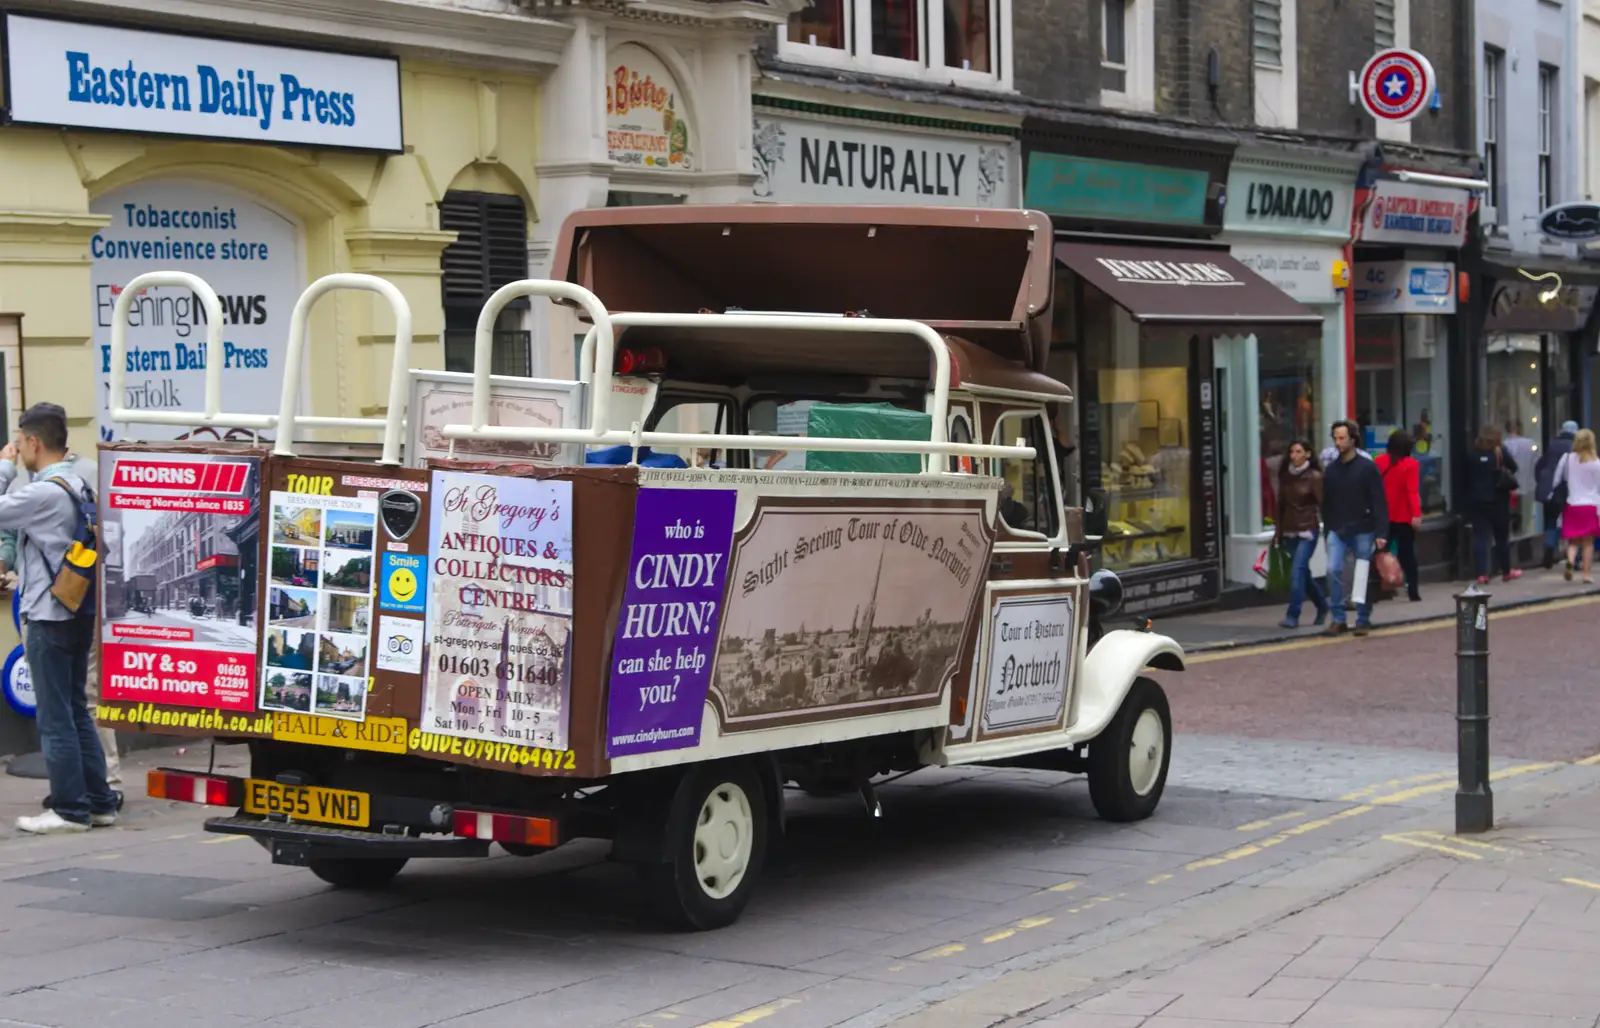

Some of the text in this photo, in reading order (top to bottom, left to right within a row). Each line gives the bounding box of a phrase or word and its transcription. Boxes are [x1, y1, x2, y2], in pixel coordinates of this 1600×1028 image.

[66, 51, 356, 130] Eastern Daily Press
[614, 65, 667, 115] Bistro
[800, 137, 965, 196] NATURALLY
[1247, 182, 1333, 220] L'DARADO
[124, 203, 237, 229] Tobacconist
[91, 235, 268, 260] Convenience store
[1096, 257, 1235, 282] JEWELLERS
[101, 344, 171, 373] Estern
[224, 341, 268, 368] Press
[118, 465, 196, 485] THORNS
[287, 474, 334, 496] TOUR
[115, 495, 244, 511] Serving Norwich since 1835
[443, 485, 560, 532] St Gregory's
[665, 519, 705, 540] who is
[440, 532, 559, 560] ANTIQUES &
[742, 548, 789, 598] Sight
[793, 527, 843, 564] Seeing
[847, 517, 880, 541] Tour
[883, 517, 899, 540] of
[900, 520, 928, 551] Olde
[928, 536, 973, 588] Norwich
[389, 554, 420, 568] Smile
[435, 557, 566, 588] COLLECTORS
[635, 553, 722, 590] CINDY
[459, 587, 538, 611] CENTRE
[443, 610, 497, 636] Pottergate
[622, 601, 716, 639] HURN?
[1001, 622, 1021, 642] Tour
[1024, 621, 1032, 639] of
[124, 651, 197, 674] DIY & so
[217, 664, 247, 676] 01603
[438, 654, 558, 686] 01603 631640
[618, 646, 706, 675] can she help
[996, 648, 1060, 695] Norwich
[111, 672, 208, 695] much more
[214, 676, 249, 689] 622891
[458, 684, 534, 705] OPEN DAILY
[639, 675, 680, 711] you?
[450, 701, 475, 715] Mon
[485, 705, 502, 718] Fri
[512, 709, 523, 721] 10
[534, 712, 540, 724] 5
[275, 712, 404, 745] HAIL & RIDE
[408, 727, 462, 754] GUIDE
[434, 716, 452, 729] Sat
[456, 719, 468, 731] 10
[478, 722, 485, 734] 6
[500, 725, 521, 738] Sun
[525, 728, 535, 741] 11
[547, 732, 554, 743] 4
[612, 725, 694, 746] www.cindyhurn.com
[253, 784, 360, 821] E655 VND
